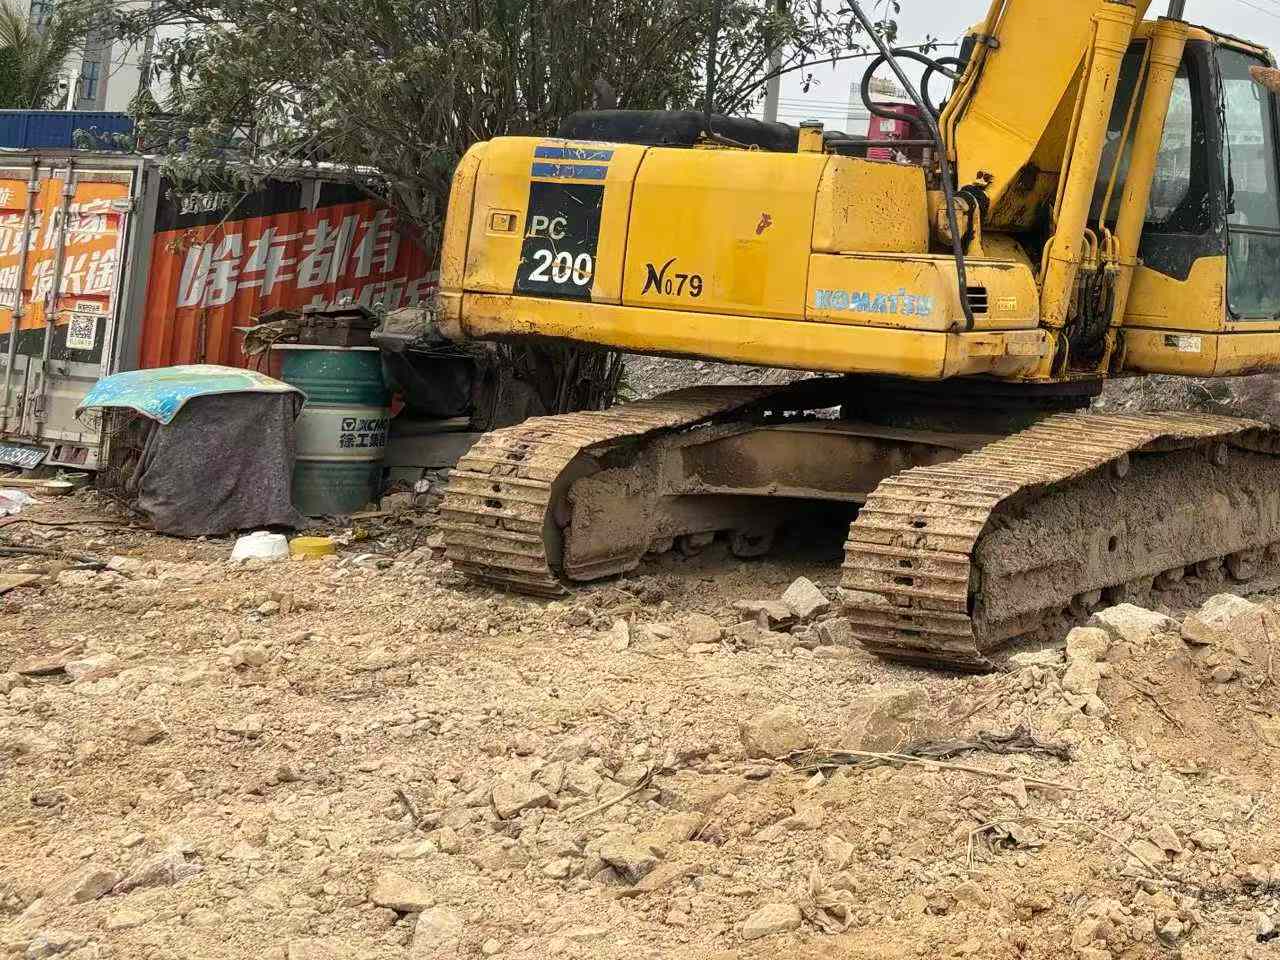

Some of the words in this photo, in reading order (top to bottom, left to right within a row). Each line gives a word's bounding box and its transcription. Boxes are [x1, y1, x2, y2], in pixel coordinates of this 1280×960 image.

[531, 215, 568, 240] PC
[176, 209, 399, 308] 啥车都有
[528, 249, 592, 286] 200
